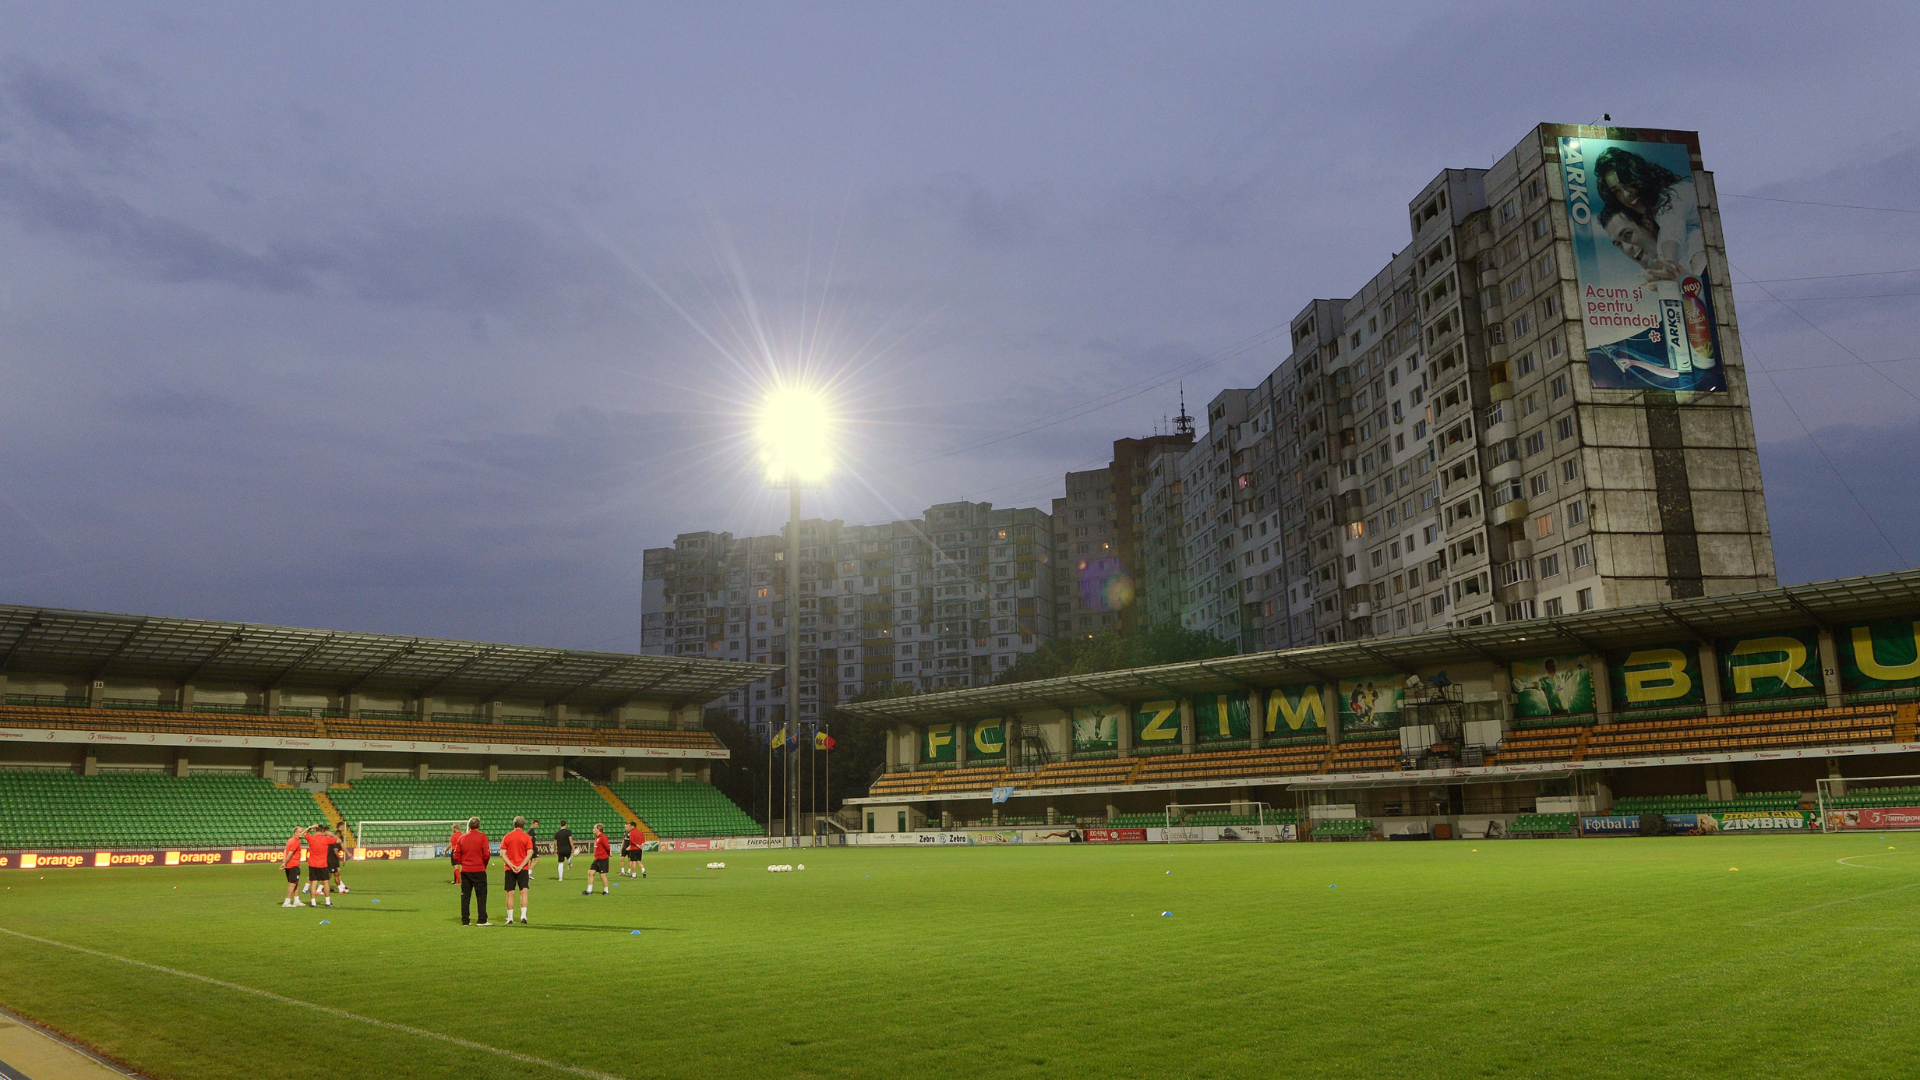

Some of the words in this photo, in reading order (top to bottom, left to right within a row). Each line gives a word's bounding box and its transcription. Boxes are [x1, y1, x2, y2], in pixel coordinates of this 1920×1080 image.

[1563, 144, 1591, 225] ARKO
[1586, 285, 1628, 298] Acum
[1684, 282, 1701, 293] NOU
[1587, 300, 1633, 314] pentru
[1590, 313, 1658, 327] amândoi!
[1667, 308, 1680, 348] ARKO
[1722, 812, 1770, 821] FITNESS
[1870, 812, 1880, 822] 5
[1722, 818, 1804, 830] ZIMBRU
[37, 856, 83, 868] orange
[110, 854, 154, 866] orange
[180, 852, 221, 864] orange
[244, 850, 284, 862] orange
